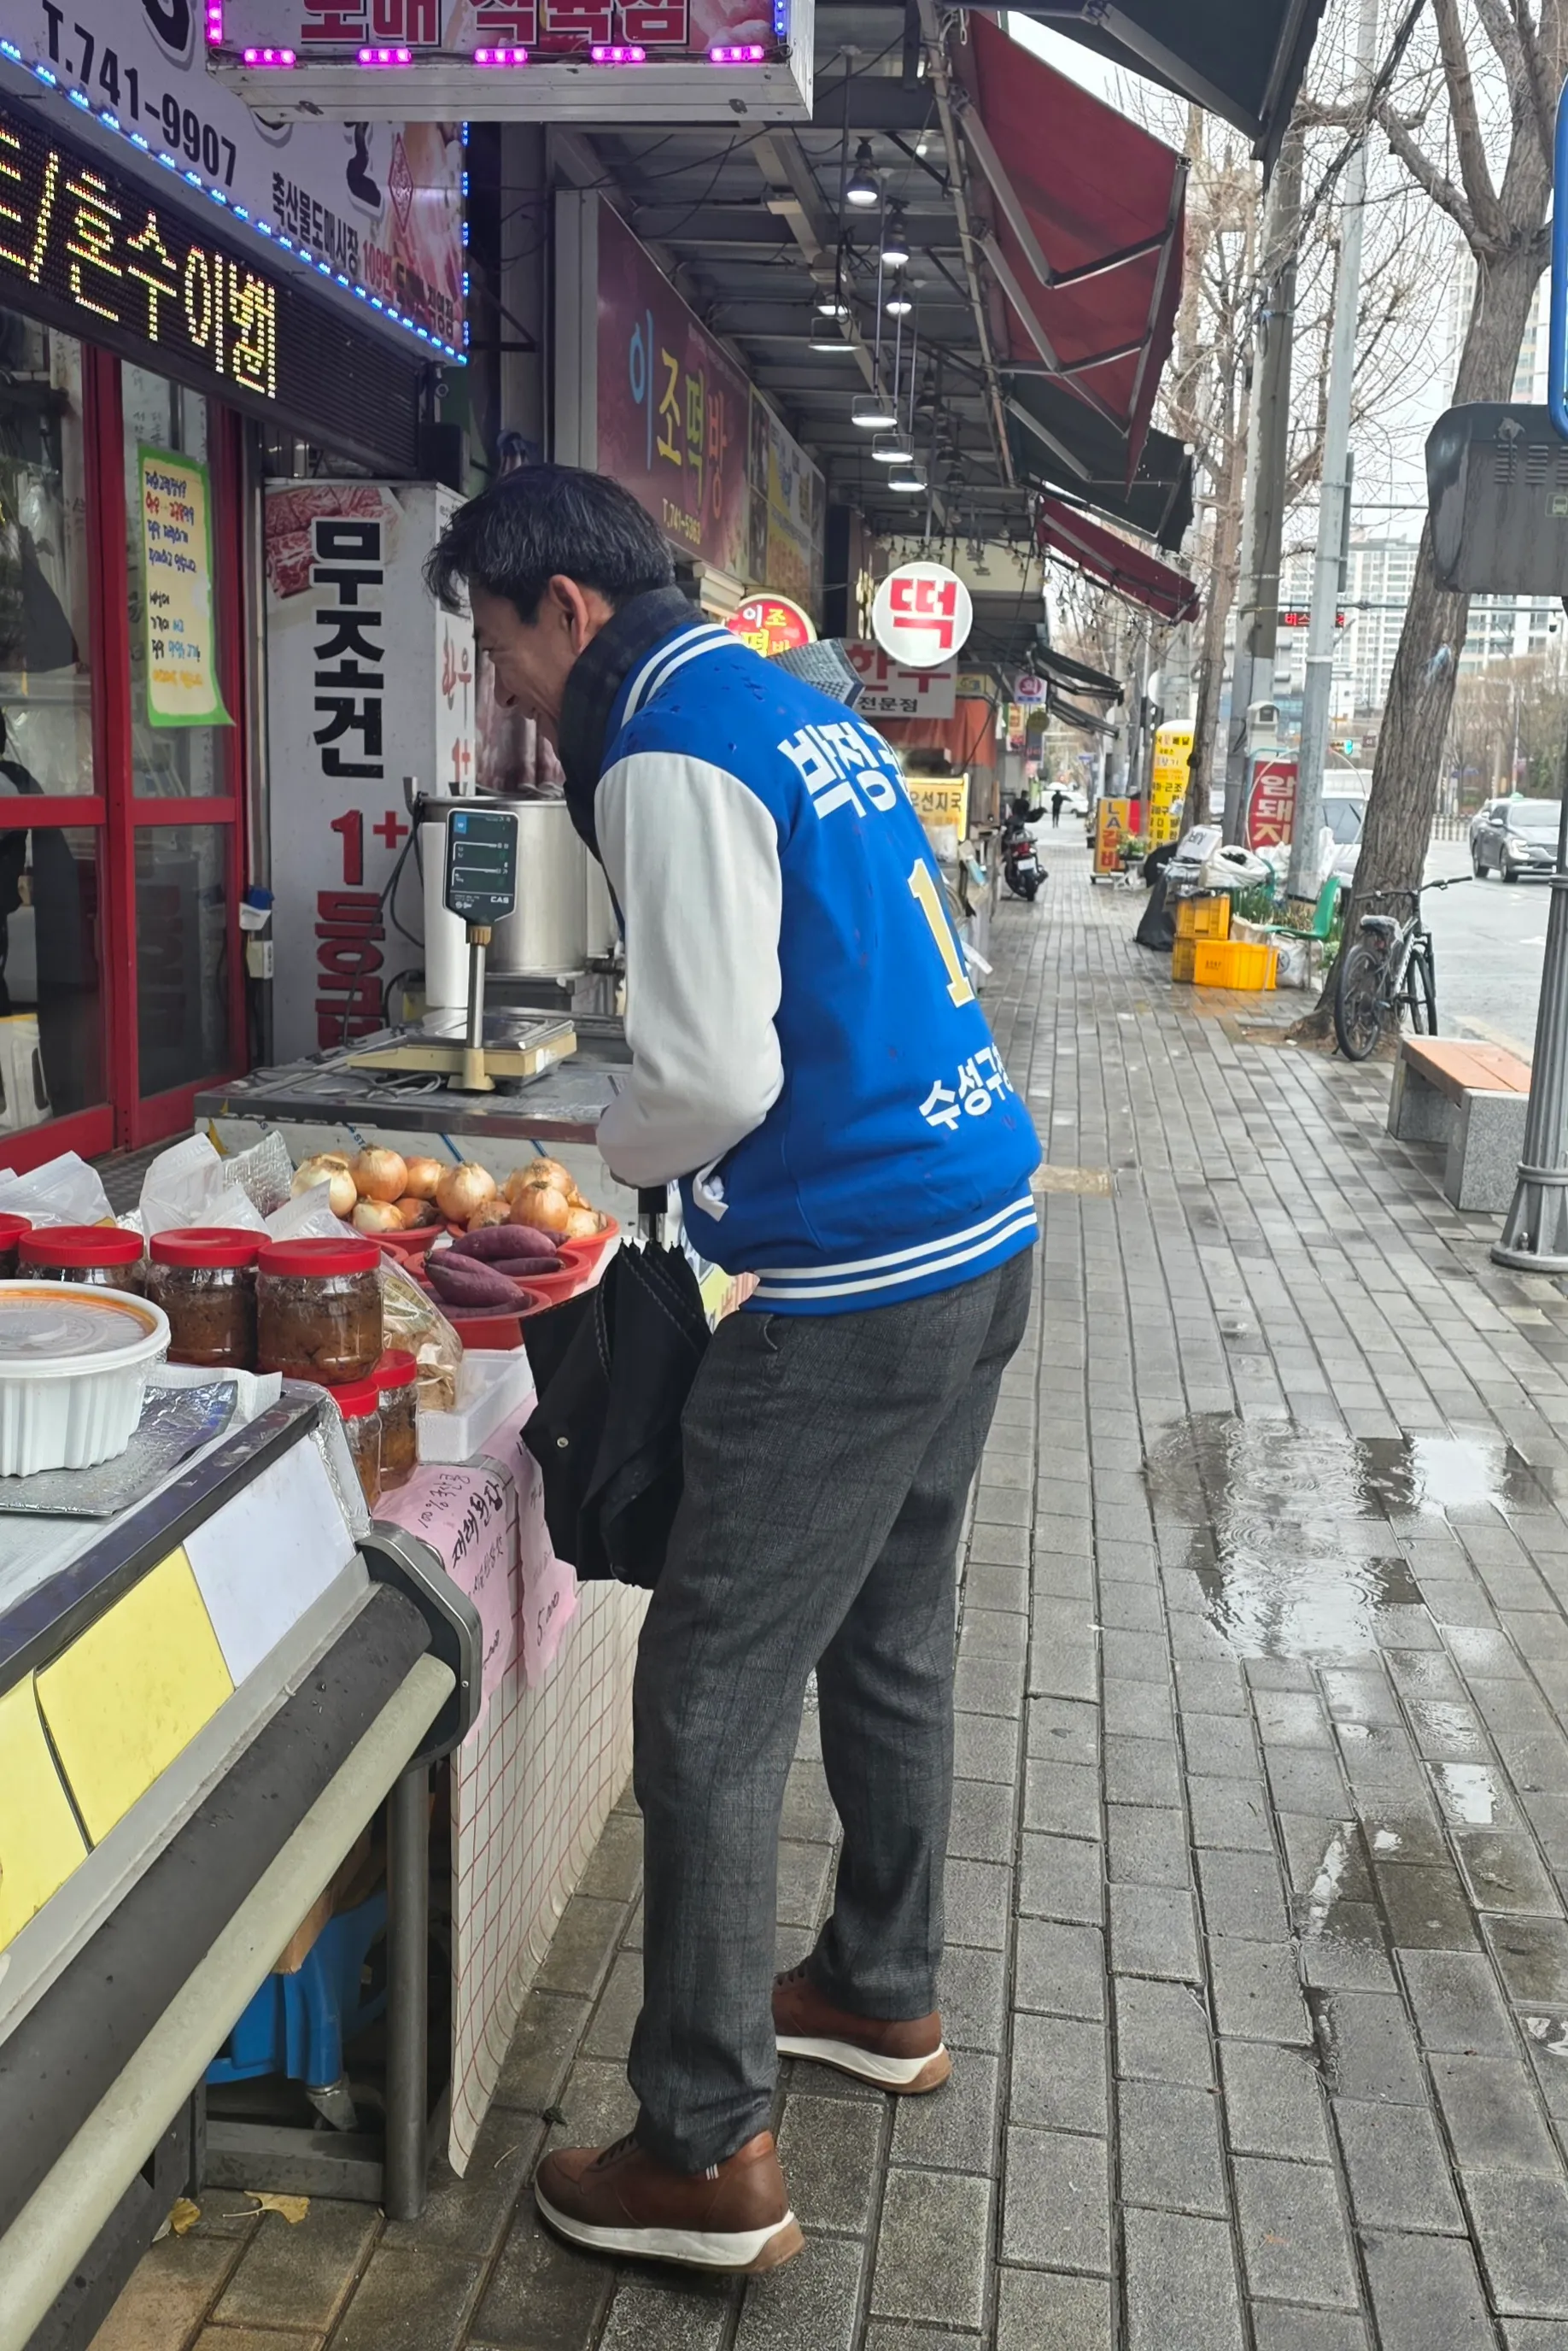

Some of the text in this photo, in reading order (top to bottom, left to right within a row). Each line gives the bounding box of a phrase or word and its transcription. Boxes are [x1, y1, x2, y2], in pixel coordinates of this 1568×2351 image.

[43, 0, 237, 187] T.741-9907
[272, 171, 359, 278] 축산물도매시장
[629, 308, 727, 520] 이조떡방
[313, 520, 385, 778] 무조건
[742, 604, 787, 628] 이조
[889, 577, 957, 649] 떡
[1284, 613, 1311, 626] 버스
[857, 696, 918, 712] 전문점
[1253, 775, 1297, 845] 암돼지
[490, 895, 510, 904] CAS
[907, 857, 975, 1009] 1
